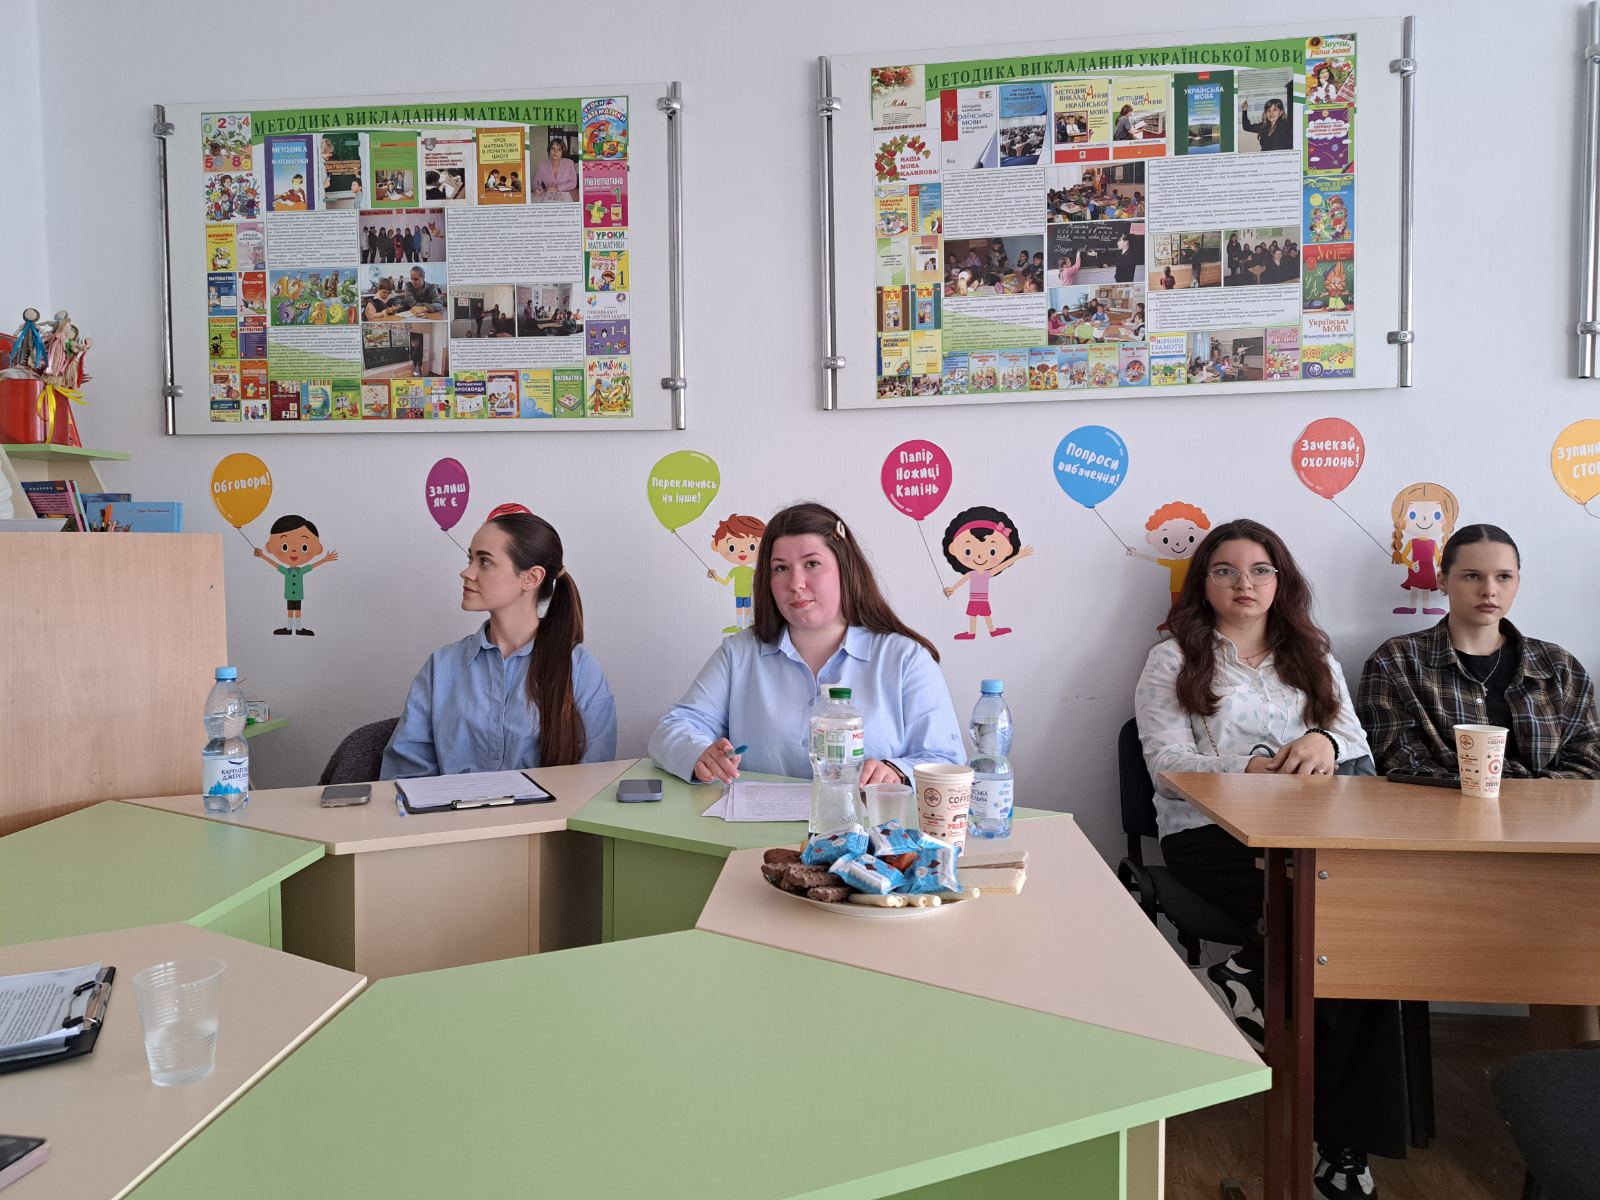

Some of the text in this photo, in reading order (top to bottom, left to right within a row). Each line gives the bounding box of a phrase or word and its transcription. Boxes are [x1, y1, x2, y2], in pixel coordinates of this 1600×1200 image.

[927, 45, 1303, 91] МЕТОДИКА ВИКЛАДАННЯ УКРАЇНСЬКОЇ МОВИ
[1183, 86, 1224, 96] УКРАЇНСЬКА
[254, 106, 578, 136] МЕТОДИКА ВИКЛАДАННЯ МАТЕМАТИКИ
[272, 146, 308, 154] МЕТОДИКА
[900, 155, 921, 163] НАША
[900, 169, 937, 177] КАЛИНОВА
[596, 231, 625, 240] УРОКИ
[588, 240, 625, 250] МАТЕМАТИКИ
[1322, 325, 1347, 333] МОВА
[588, 360, 627, 372] МАТЕМАТИКА
[1301, 436, 1360, 452] Зачекай,
[900, 448, 934, 465] Папір
[1066, 441, 1120, 471] Попроси
[1301, 453, 1360, 468] охолонь!
[896, 463, 940, 481] Ножиці
[1058, 461, 1120, 486] вибачення!
[213, 470, 271, 494] Обговори!
[429, 482, 466, 497] Залиш
[651, 476, 718, 490] Переключись
[896, 482, 940, 498] Камінь
[662, 493, 673, 503] на
